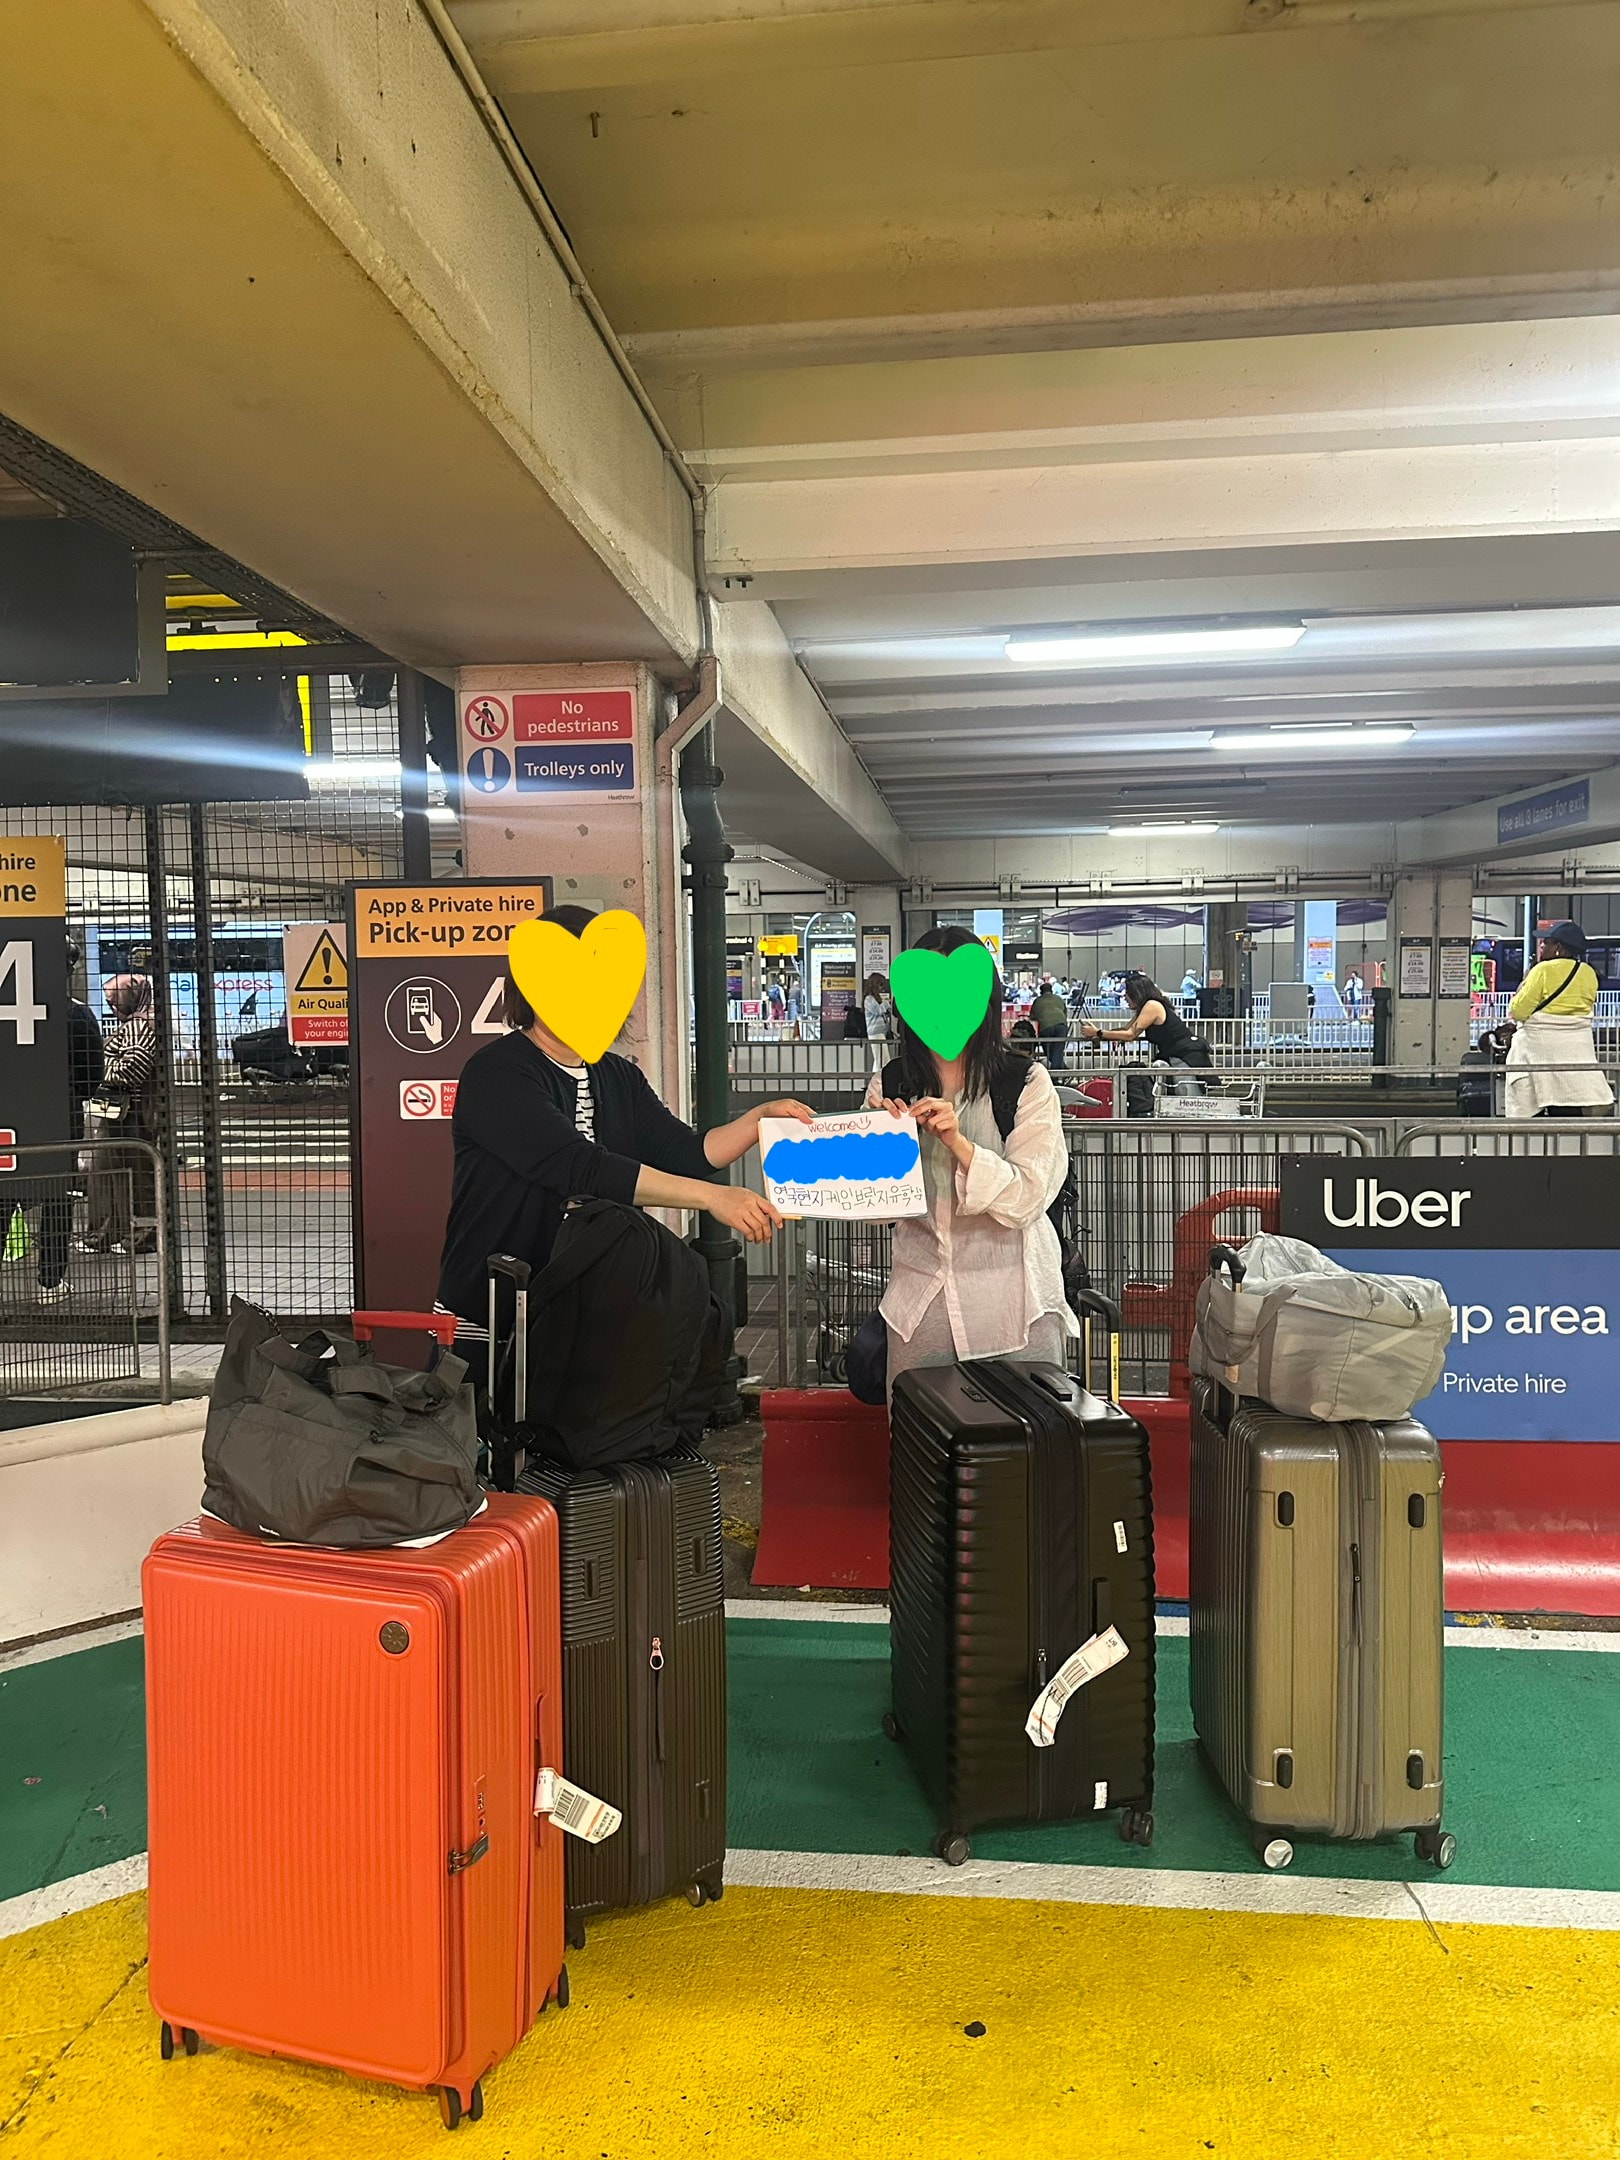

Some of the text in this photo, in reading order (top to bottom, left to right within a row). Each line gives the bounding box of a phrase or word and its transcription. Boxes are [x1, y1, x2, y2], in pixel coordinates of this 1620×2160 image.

[561, 700, 584, 715] No
[527, 718, 619, 738] pedestrians
[523, 759, 625, 780] Trolleys only
[1499, 792, 1586, 833] Use all 3 lanes for exit
[0, 853, 36, 870] hire
[0, 883, 37, 902] ne
[368, 895, 536, 917] App & Private hire
[369, 921, 465, 948] Pick-up
[297, 998, 315, 1010] Air
[308, 1019, 338, 1028] Switch
[304, 1031, 326, 1040] your
[443, 1085, 456, 1093] No
[1323, 1178, 1472, 1228] Uber
[1504, 1304, 1610, 1335] area
[1443, 1372, 1567, 1394] Private hire
